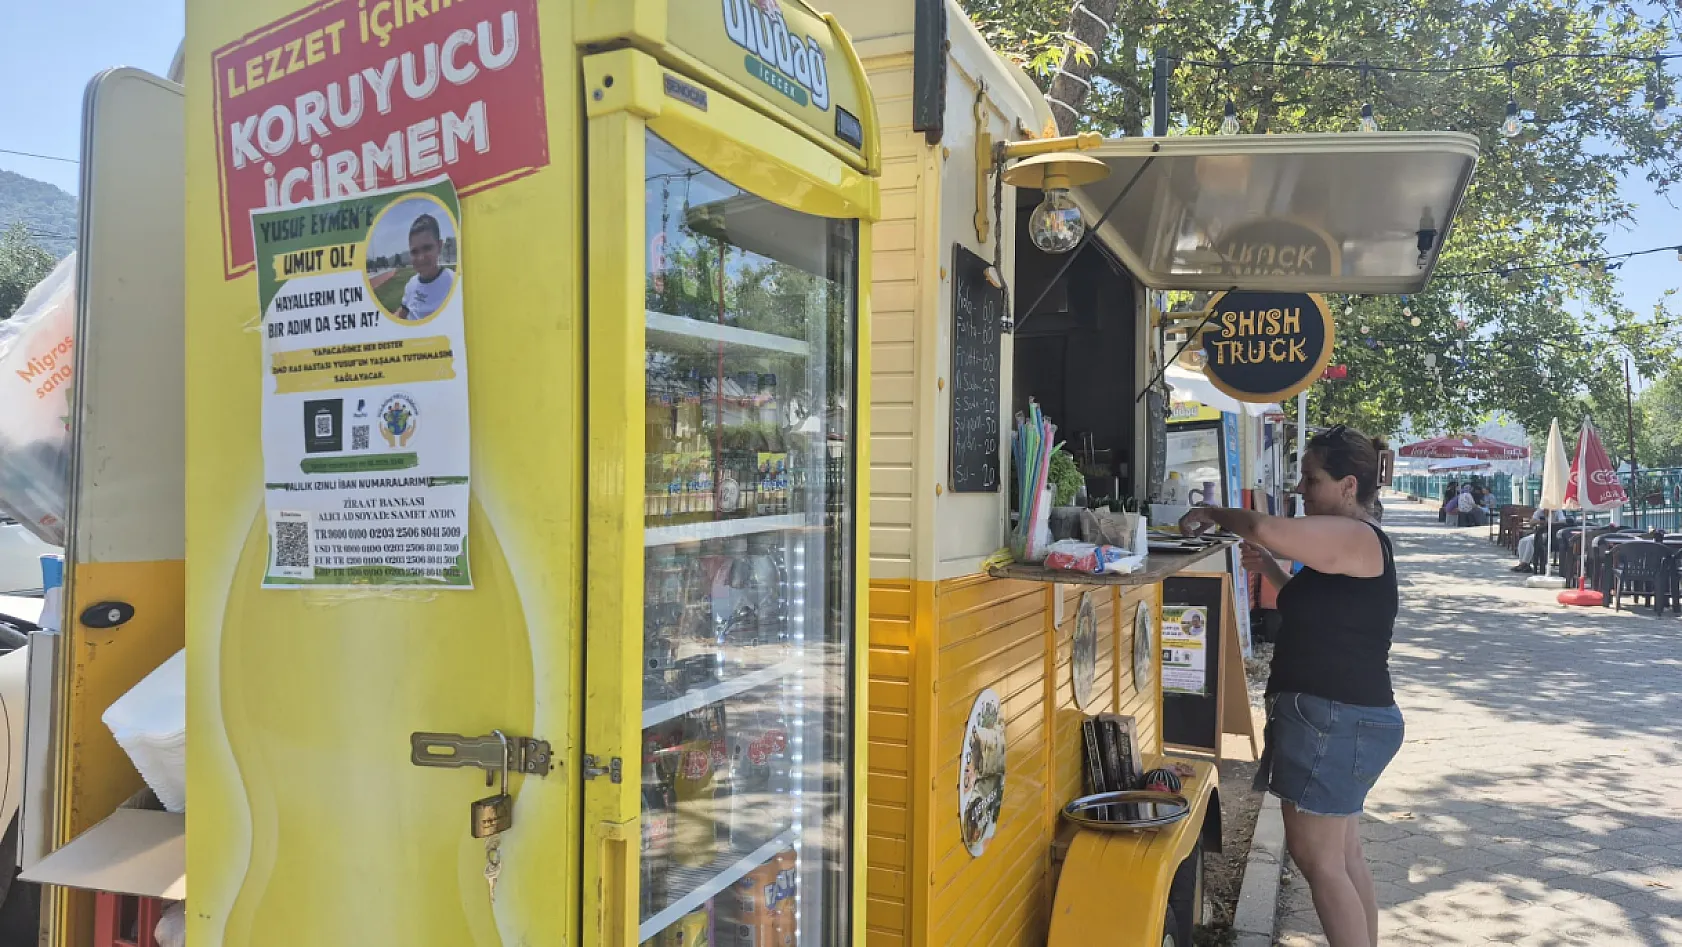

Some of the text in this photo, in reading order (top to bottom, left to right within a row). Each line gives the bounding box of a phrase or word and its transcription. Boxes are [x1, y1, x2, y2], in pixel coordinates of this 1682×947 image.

[227, 20, 346, 98] LEZZET
[230, 10, 519, 169] KORUYUCU
[260, 216, 305, 243] YUSUF
[283, 244, 355, 275] UMUT OL!
[287, 319, 312, 336] ADIM
[315, 316, 331, 333] DA
[334, 314, 356, 331] SEN
[360, 311, 379, 327] AT!
[1221, 307, 1301, 338] SHISH
[15, 336, 72, 383] Migros
[1211, 337, 1308, 364] TRUCK
[36, 364, 72, 399] sana
[359, 476, 435, 489] NUMARALARIMIZ
[982, 463, 995, 487] 20
[343, 496, 425, 509] ZİRAAT BANKASI
[390, 509, 427, 520] SAMET
[429, 508, 456, 519] AYDIN
[369, 527, 394, 539] 0203
[396, 526, 419, 538] 2506
